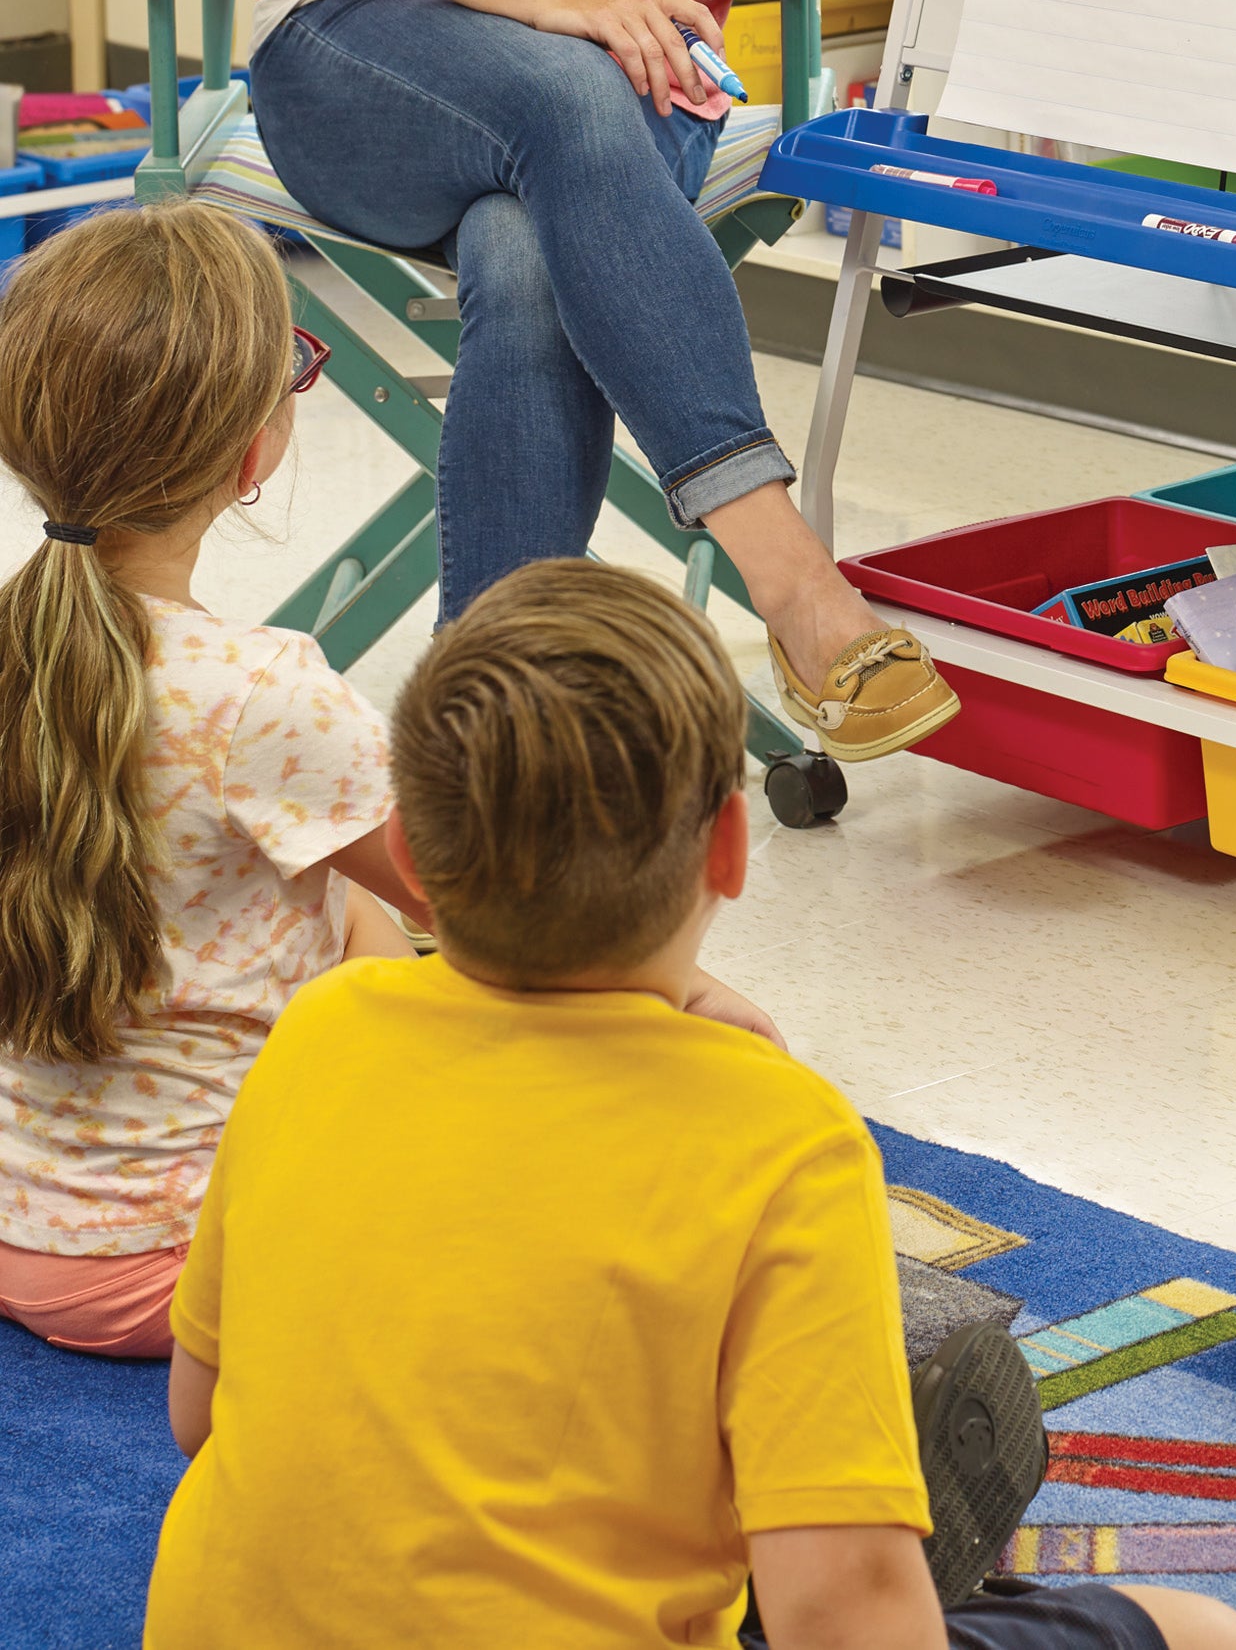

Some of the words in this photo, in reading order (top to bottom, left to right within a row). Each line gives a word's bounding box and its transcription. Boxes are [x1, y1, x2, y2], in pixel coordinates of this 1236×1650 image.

[1182, 223, 1219, 240] EXPO
[1081, 591, 1128, 621] Word
[1127, 578, 1193, 608] Building
